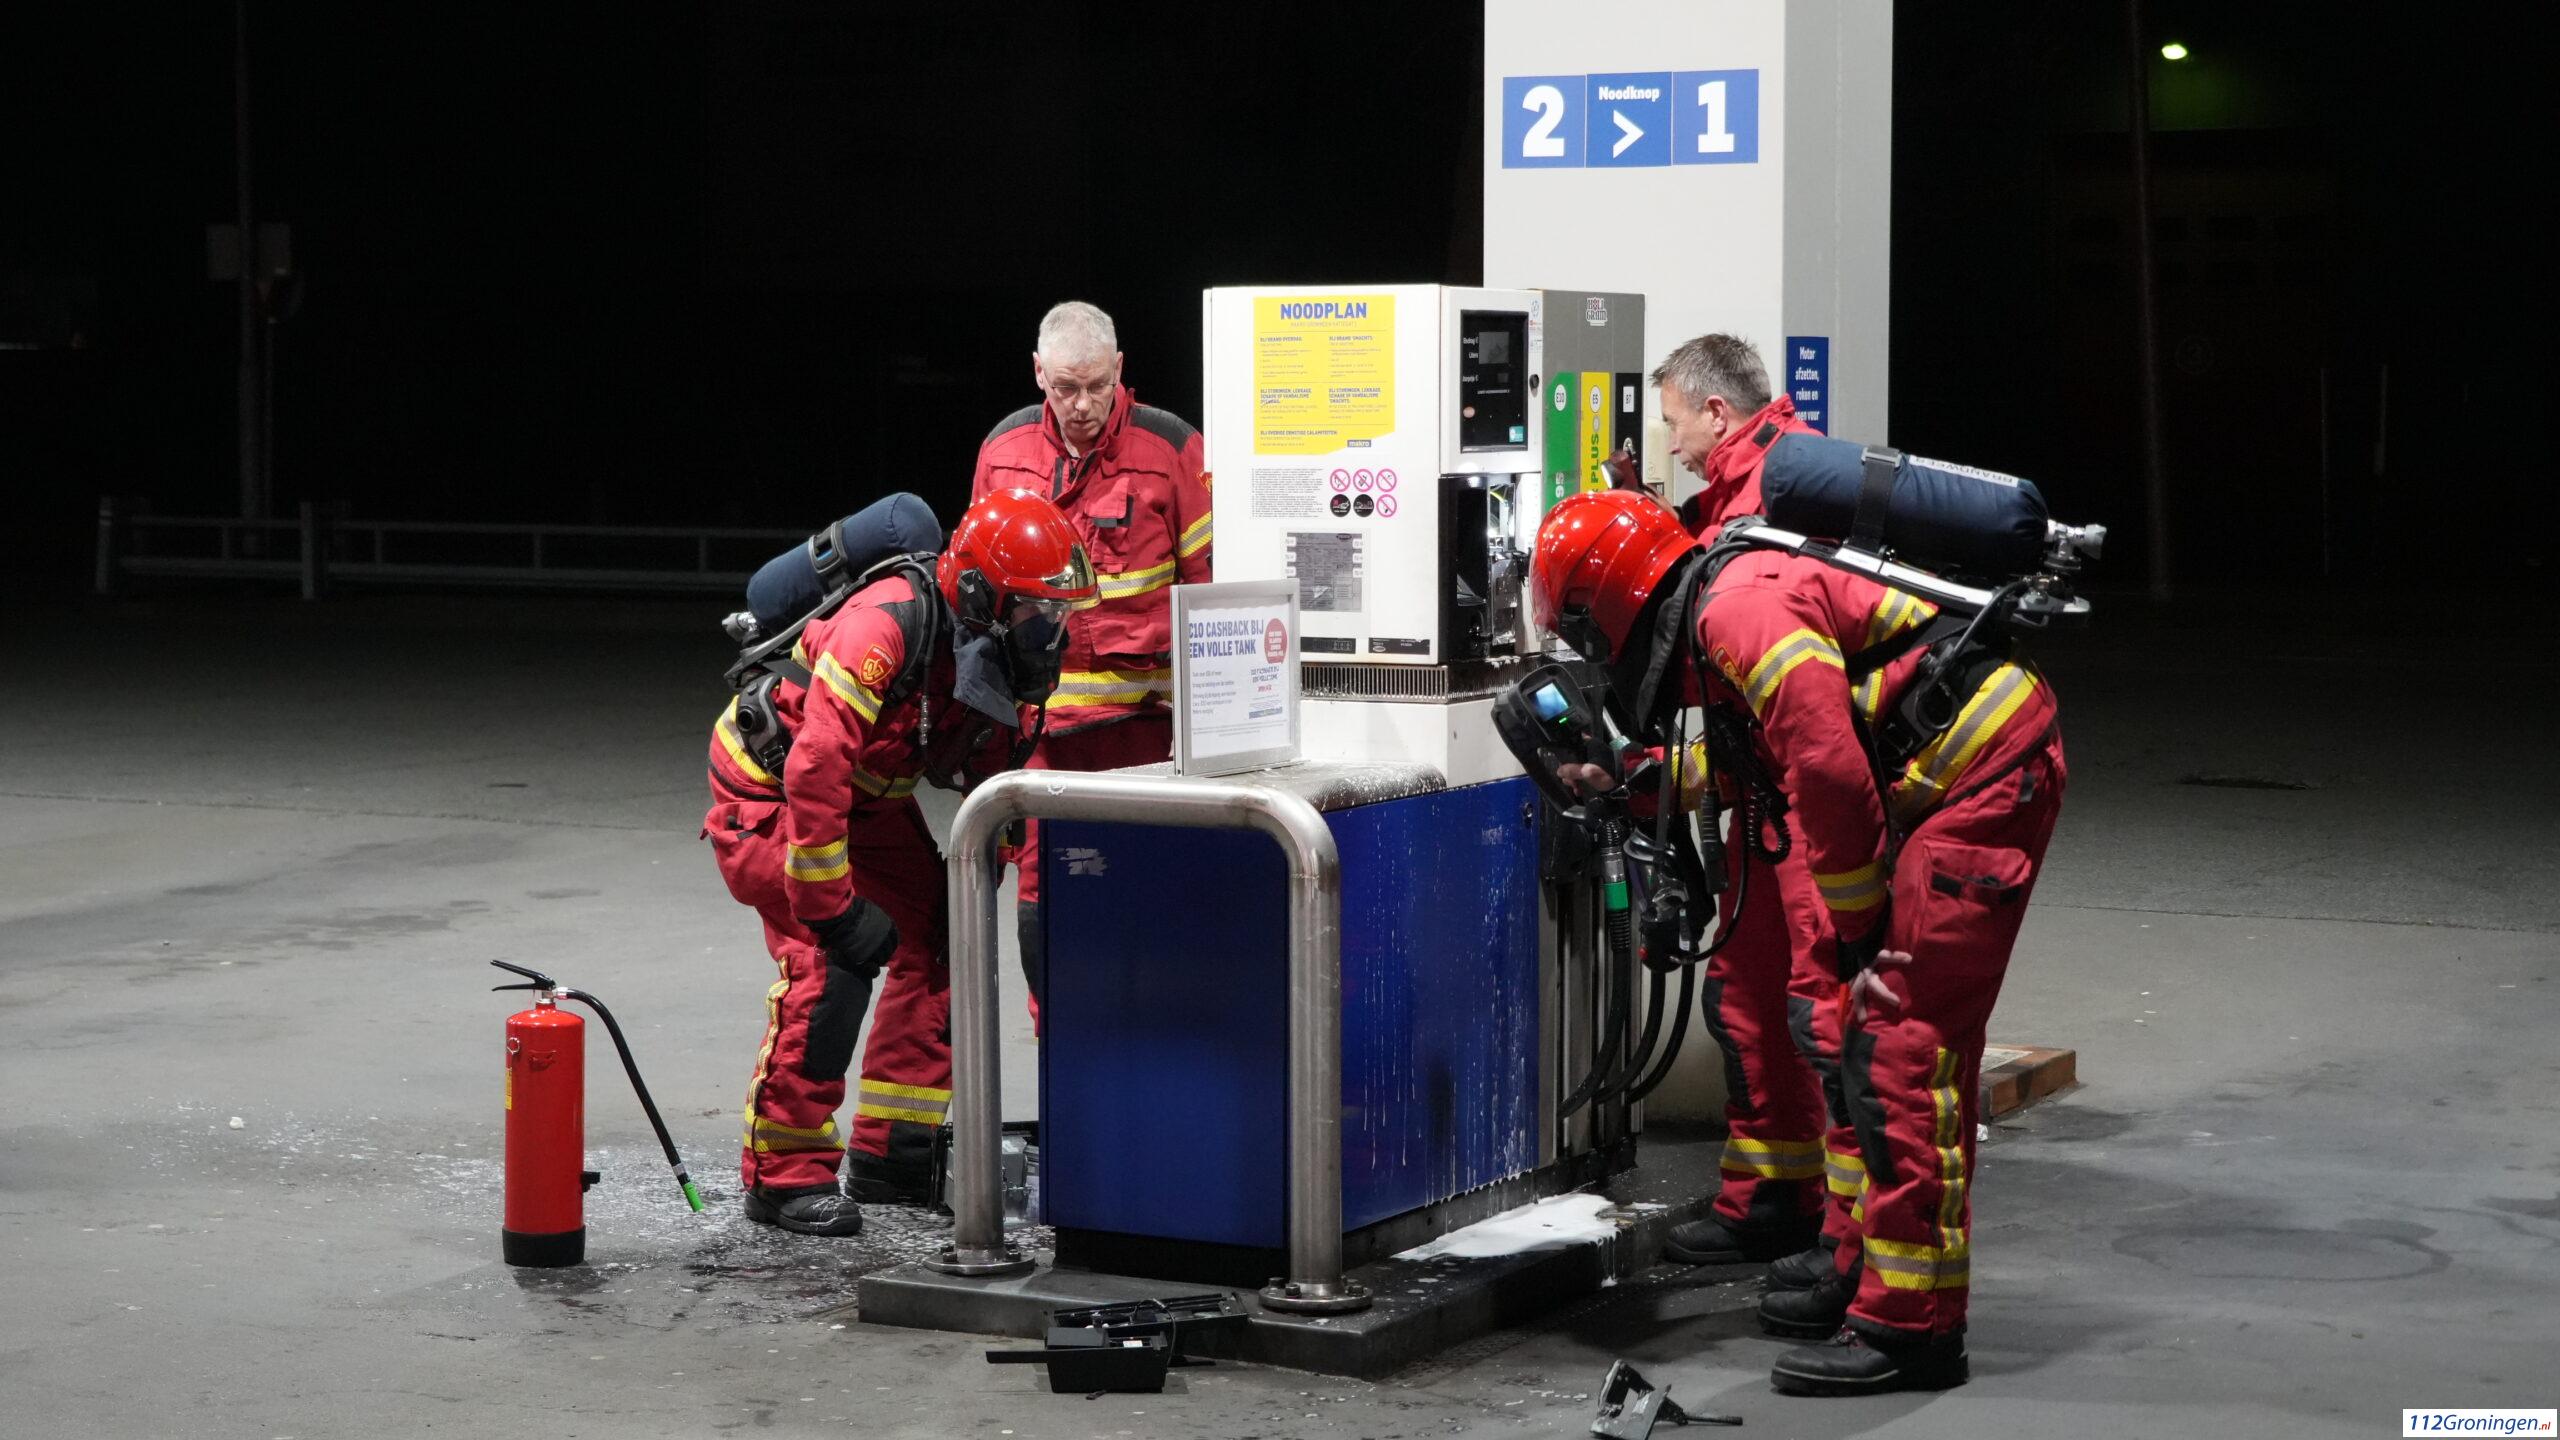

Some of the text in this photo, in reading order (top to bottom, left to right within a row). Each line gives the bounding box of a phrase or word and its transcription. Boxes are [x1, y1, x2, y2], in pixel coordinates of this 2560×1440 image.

[1598, 86, 1660, 102] Noodknop
[1522, 85, 1565, 157] 2
[1698, 81, 1734, 153] 1
[1280, 302, 1367, 320] NOODPLAN
[1800, 346, 1815, 360] Motor
[1795, 367, 1819, 382] afzetten,
[1795, 387, 1819, 401] roken en
[1591, 433, 1599, 483] PLUS
[1555, 471, 1565, 498] 95
[1206, 619, 1249, 638] CASHBACK
[1250, 618, 1264, 635] BIJ
[1206, 640, 1233, 657] VOLLE
[1234, 638, 1257, 655] TANK
